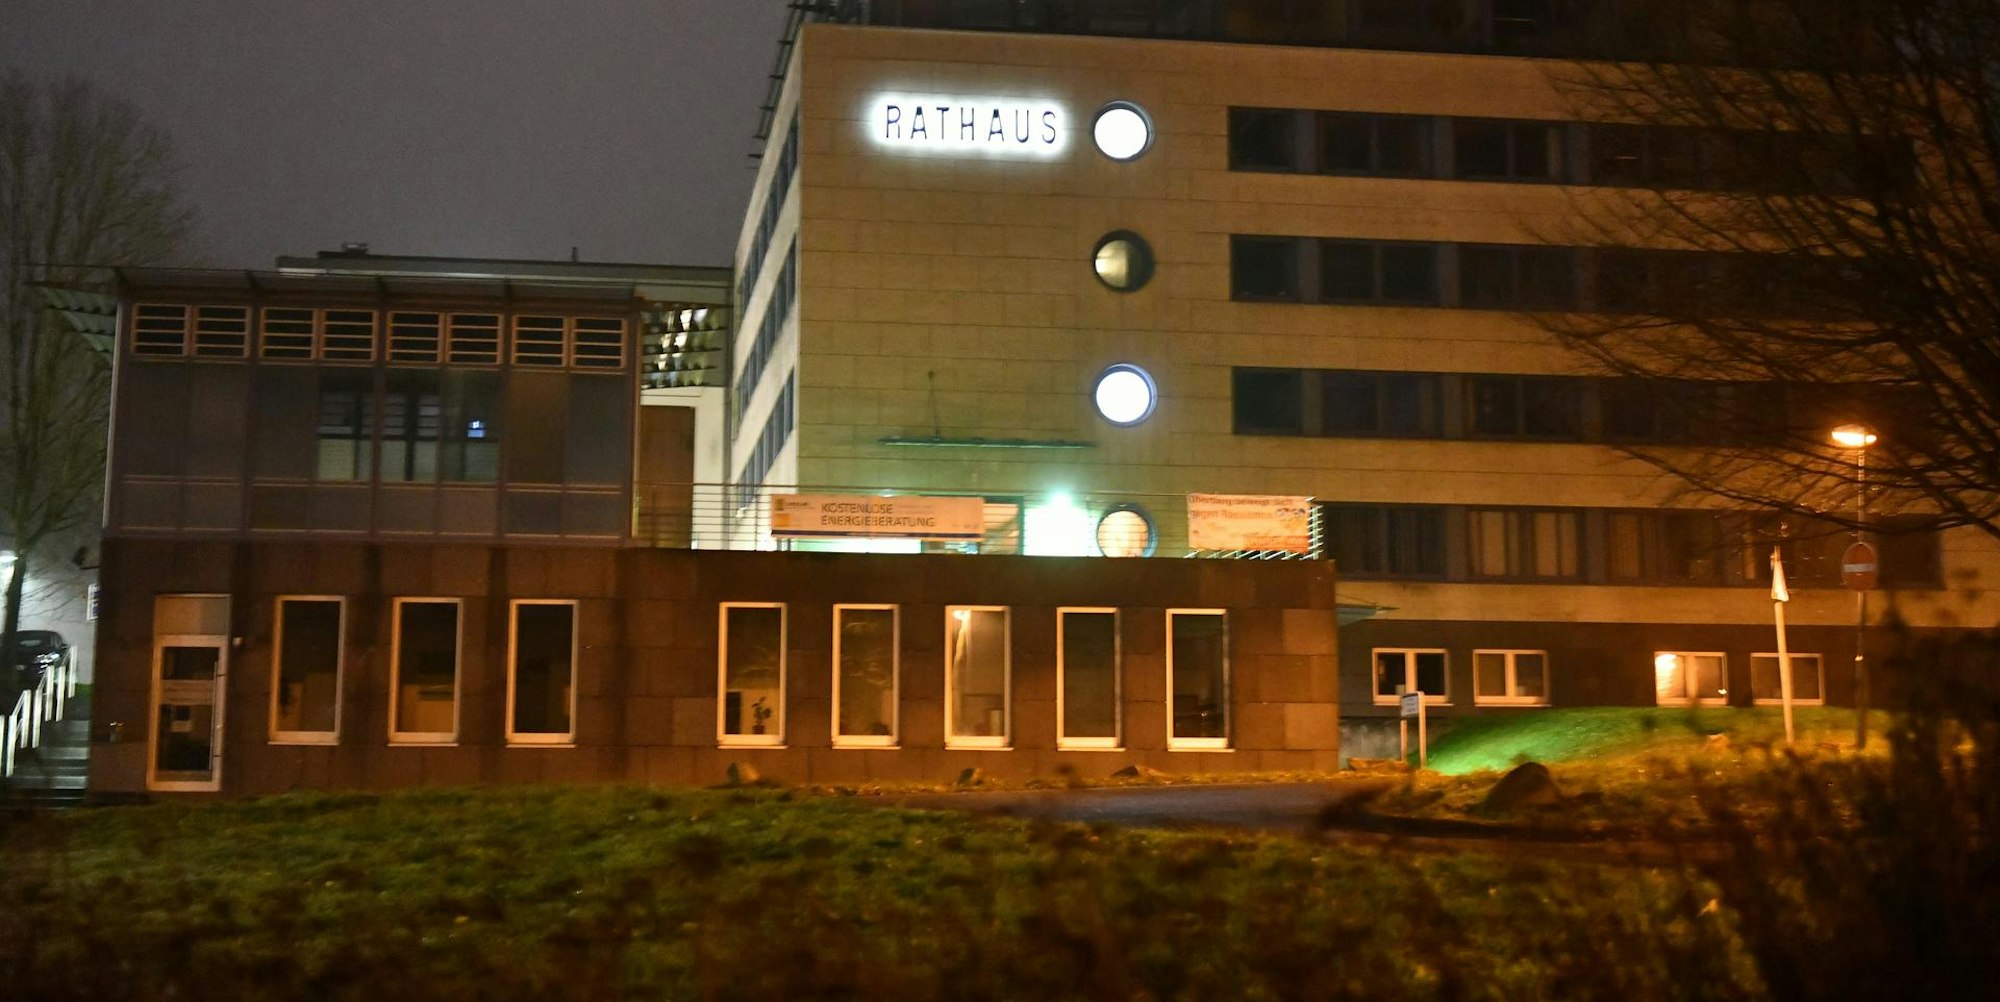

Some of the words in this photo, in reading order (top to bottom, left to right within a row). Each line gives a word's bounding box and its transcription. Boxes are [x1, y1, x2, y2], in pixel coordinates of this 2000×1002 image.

[886, 105, 1056, 144] RATHAUS
[821, 503, 893, 514] KOSTENLOSE
[821, 516, 935, 527] ENERGIEBERATUNG
